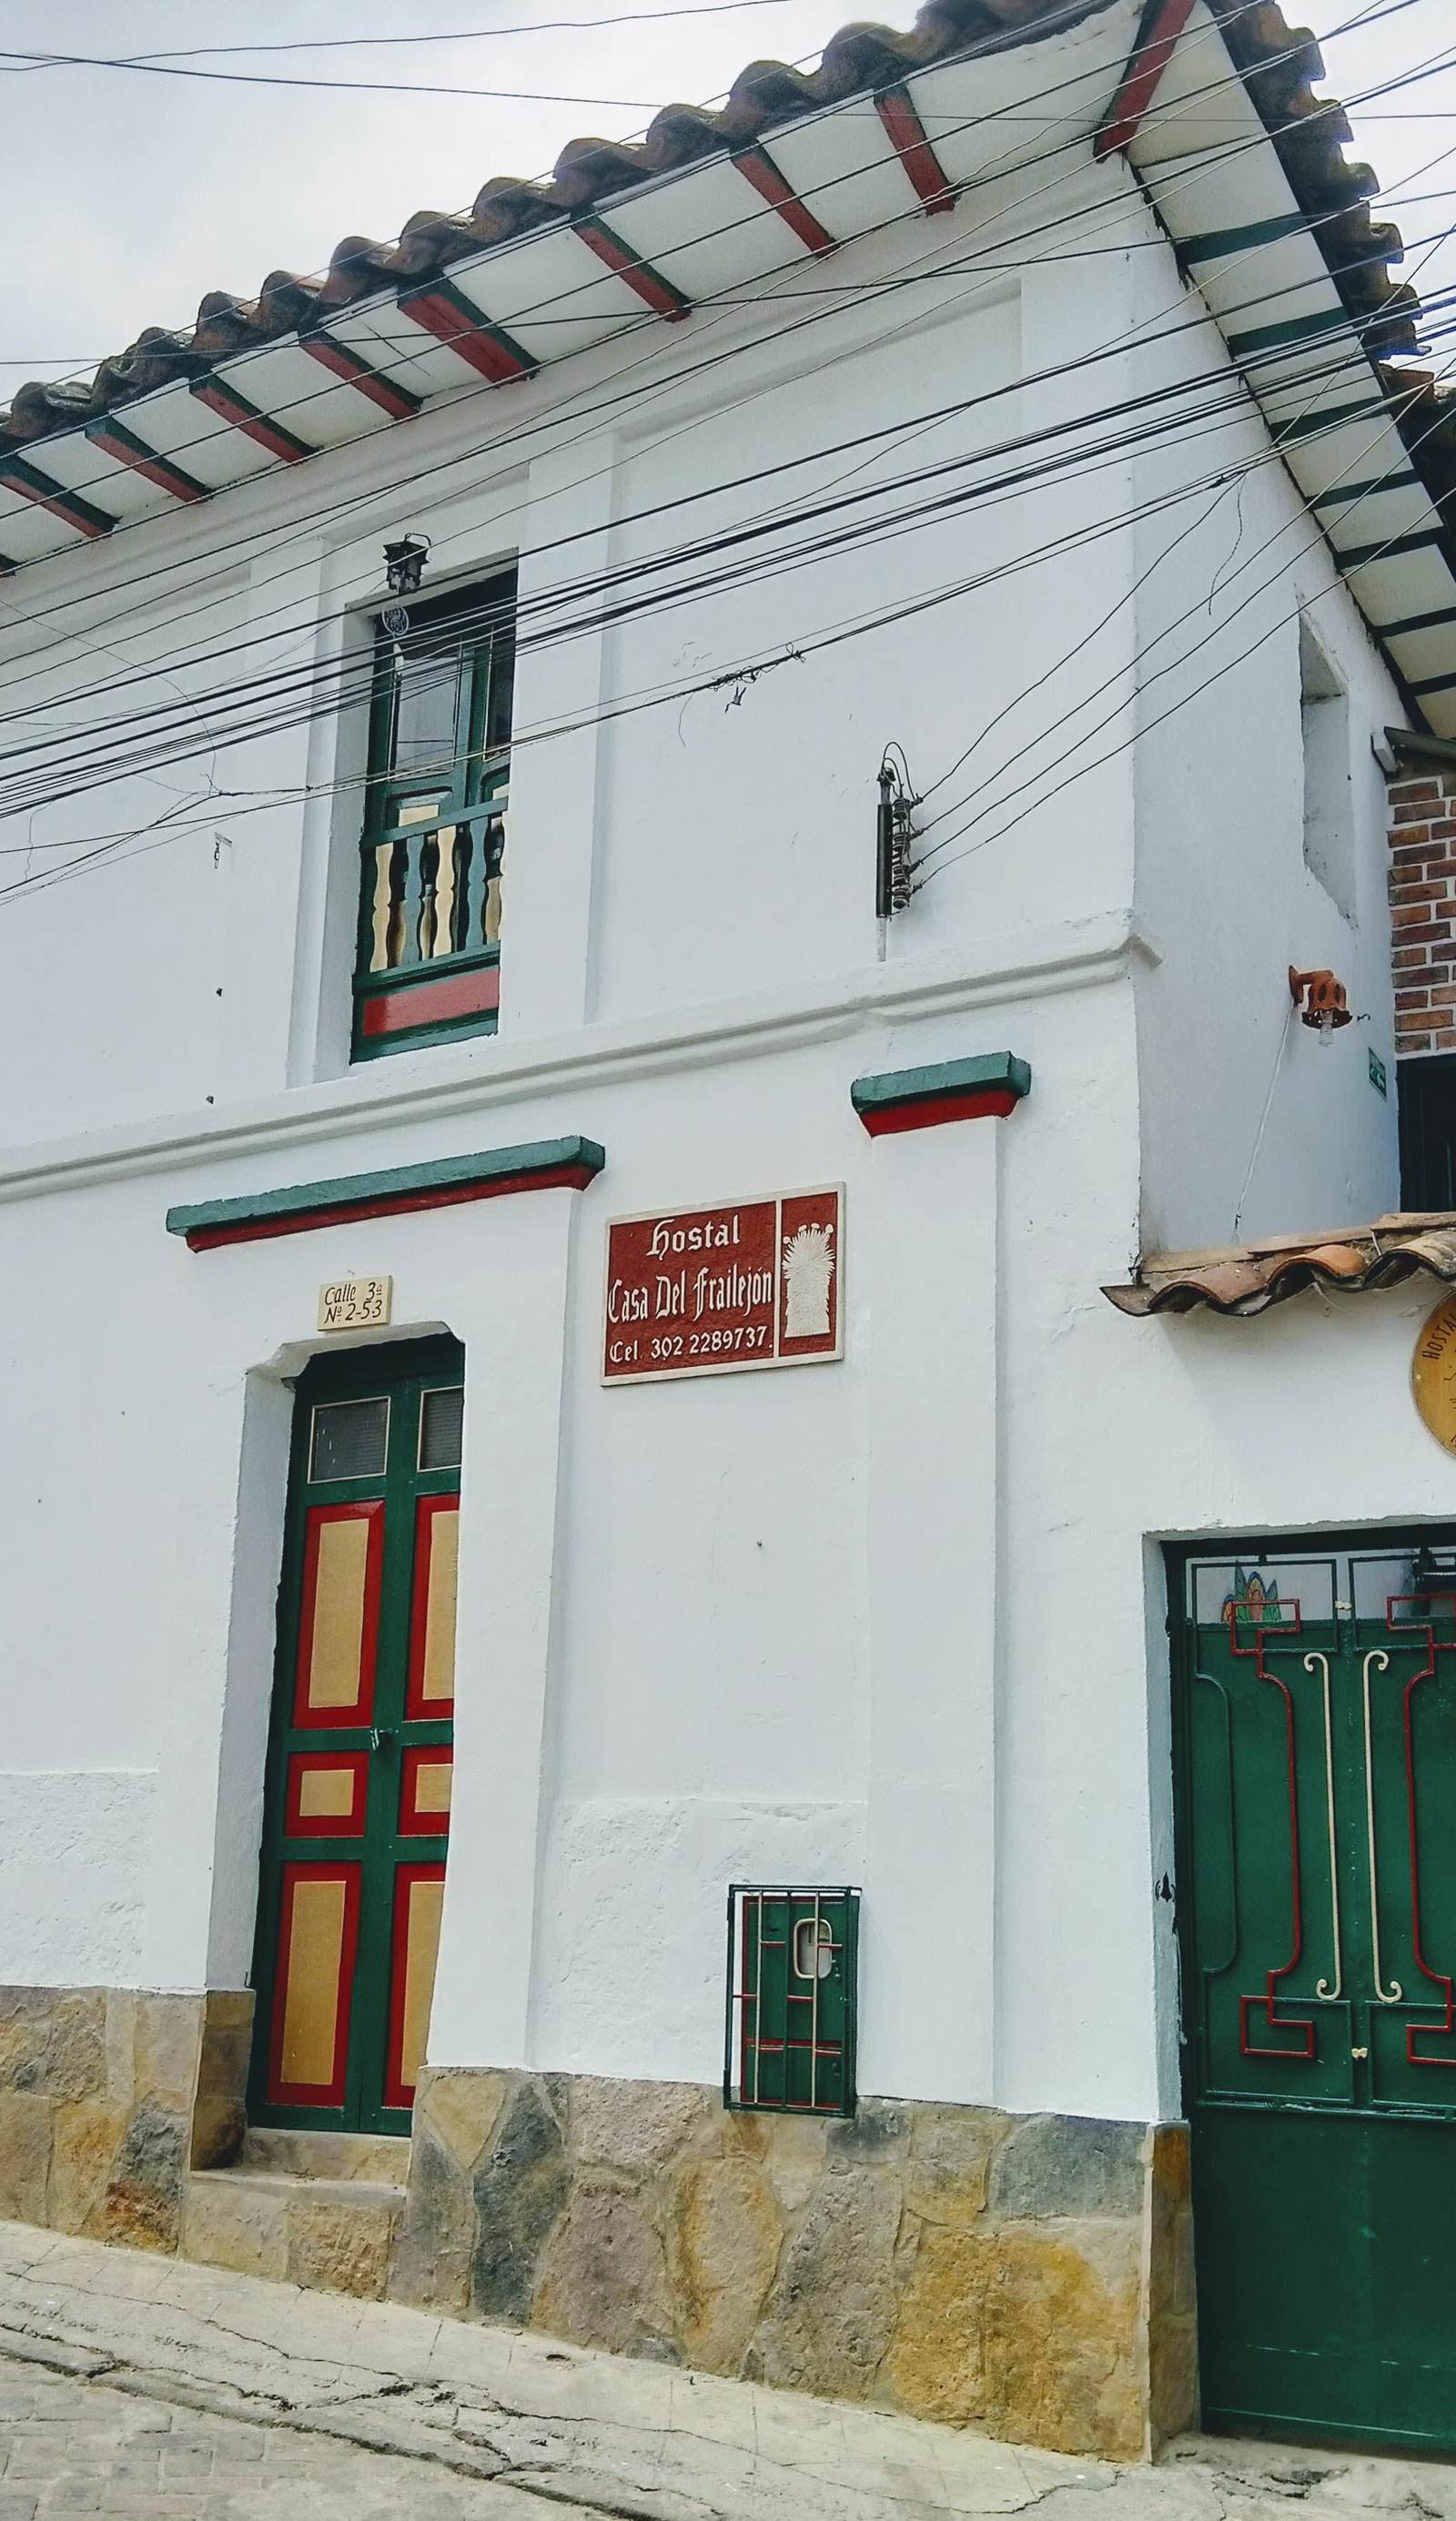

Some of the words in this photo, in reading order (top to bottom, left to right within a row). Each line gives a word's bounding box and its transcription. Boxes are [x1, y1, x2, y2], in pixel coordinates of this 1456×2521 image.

[646, 1214, 741, 1261] Hostal
[324, 1283, 357, 1306] Calle
[608, 1279, 649, 1323] Casa
[655, 1270, 686, 1320] Del
[344, 1299, 383, 1321] 2-53
[651, 1335, 684, 1361] 302
